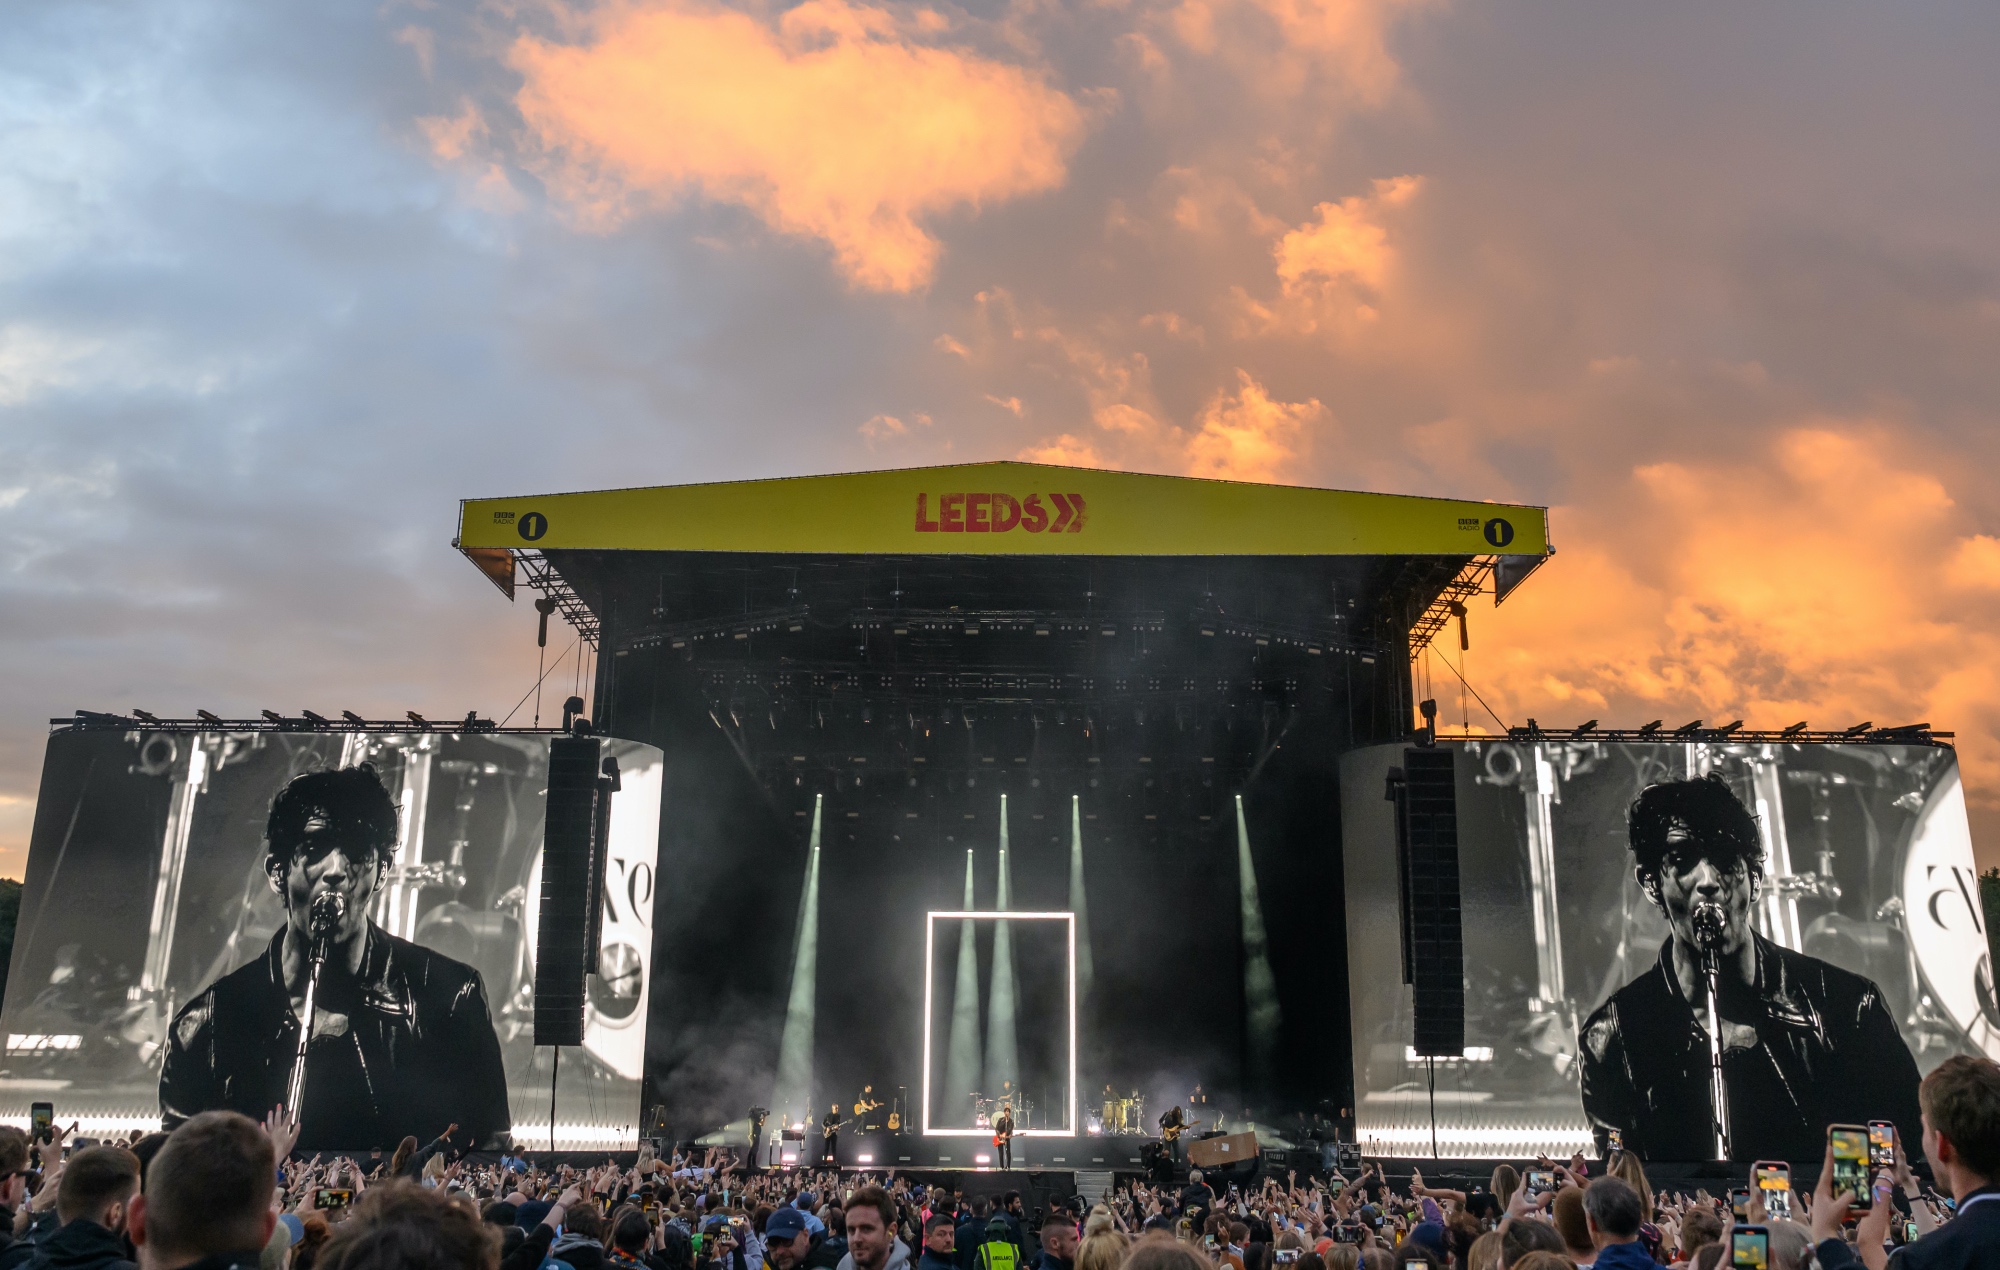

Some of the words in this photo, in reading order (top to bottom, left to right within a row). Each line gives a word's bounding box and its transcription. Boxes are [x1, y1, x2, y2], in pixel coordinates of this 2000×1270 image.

[915, 493, 1048, 533] LEEDS
[528, 516, 537, 537] 1
[1493, 522, 1503, 543] 1
